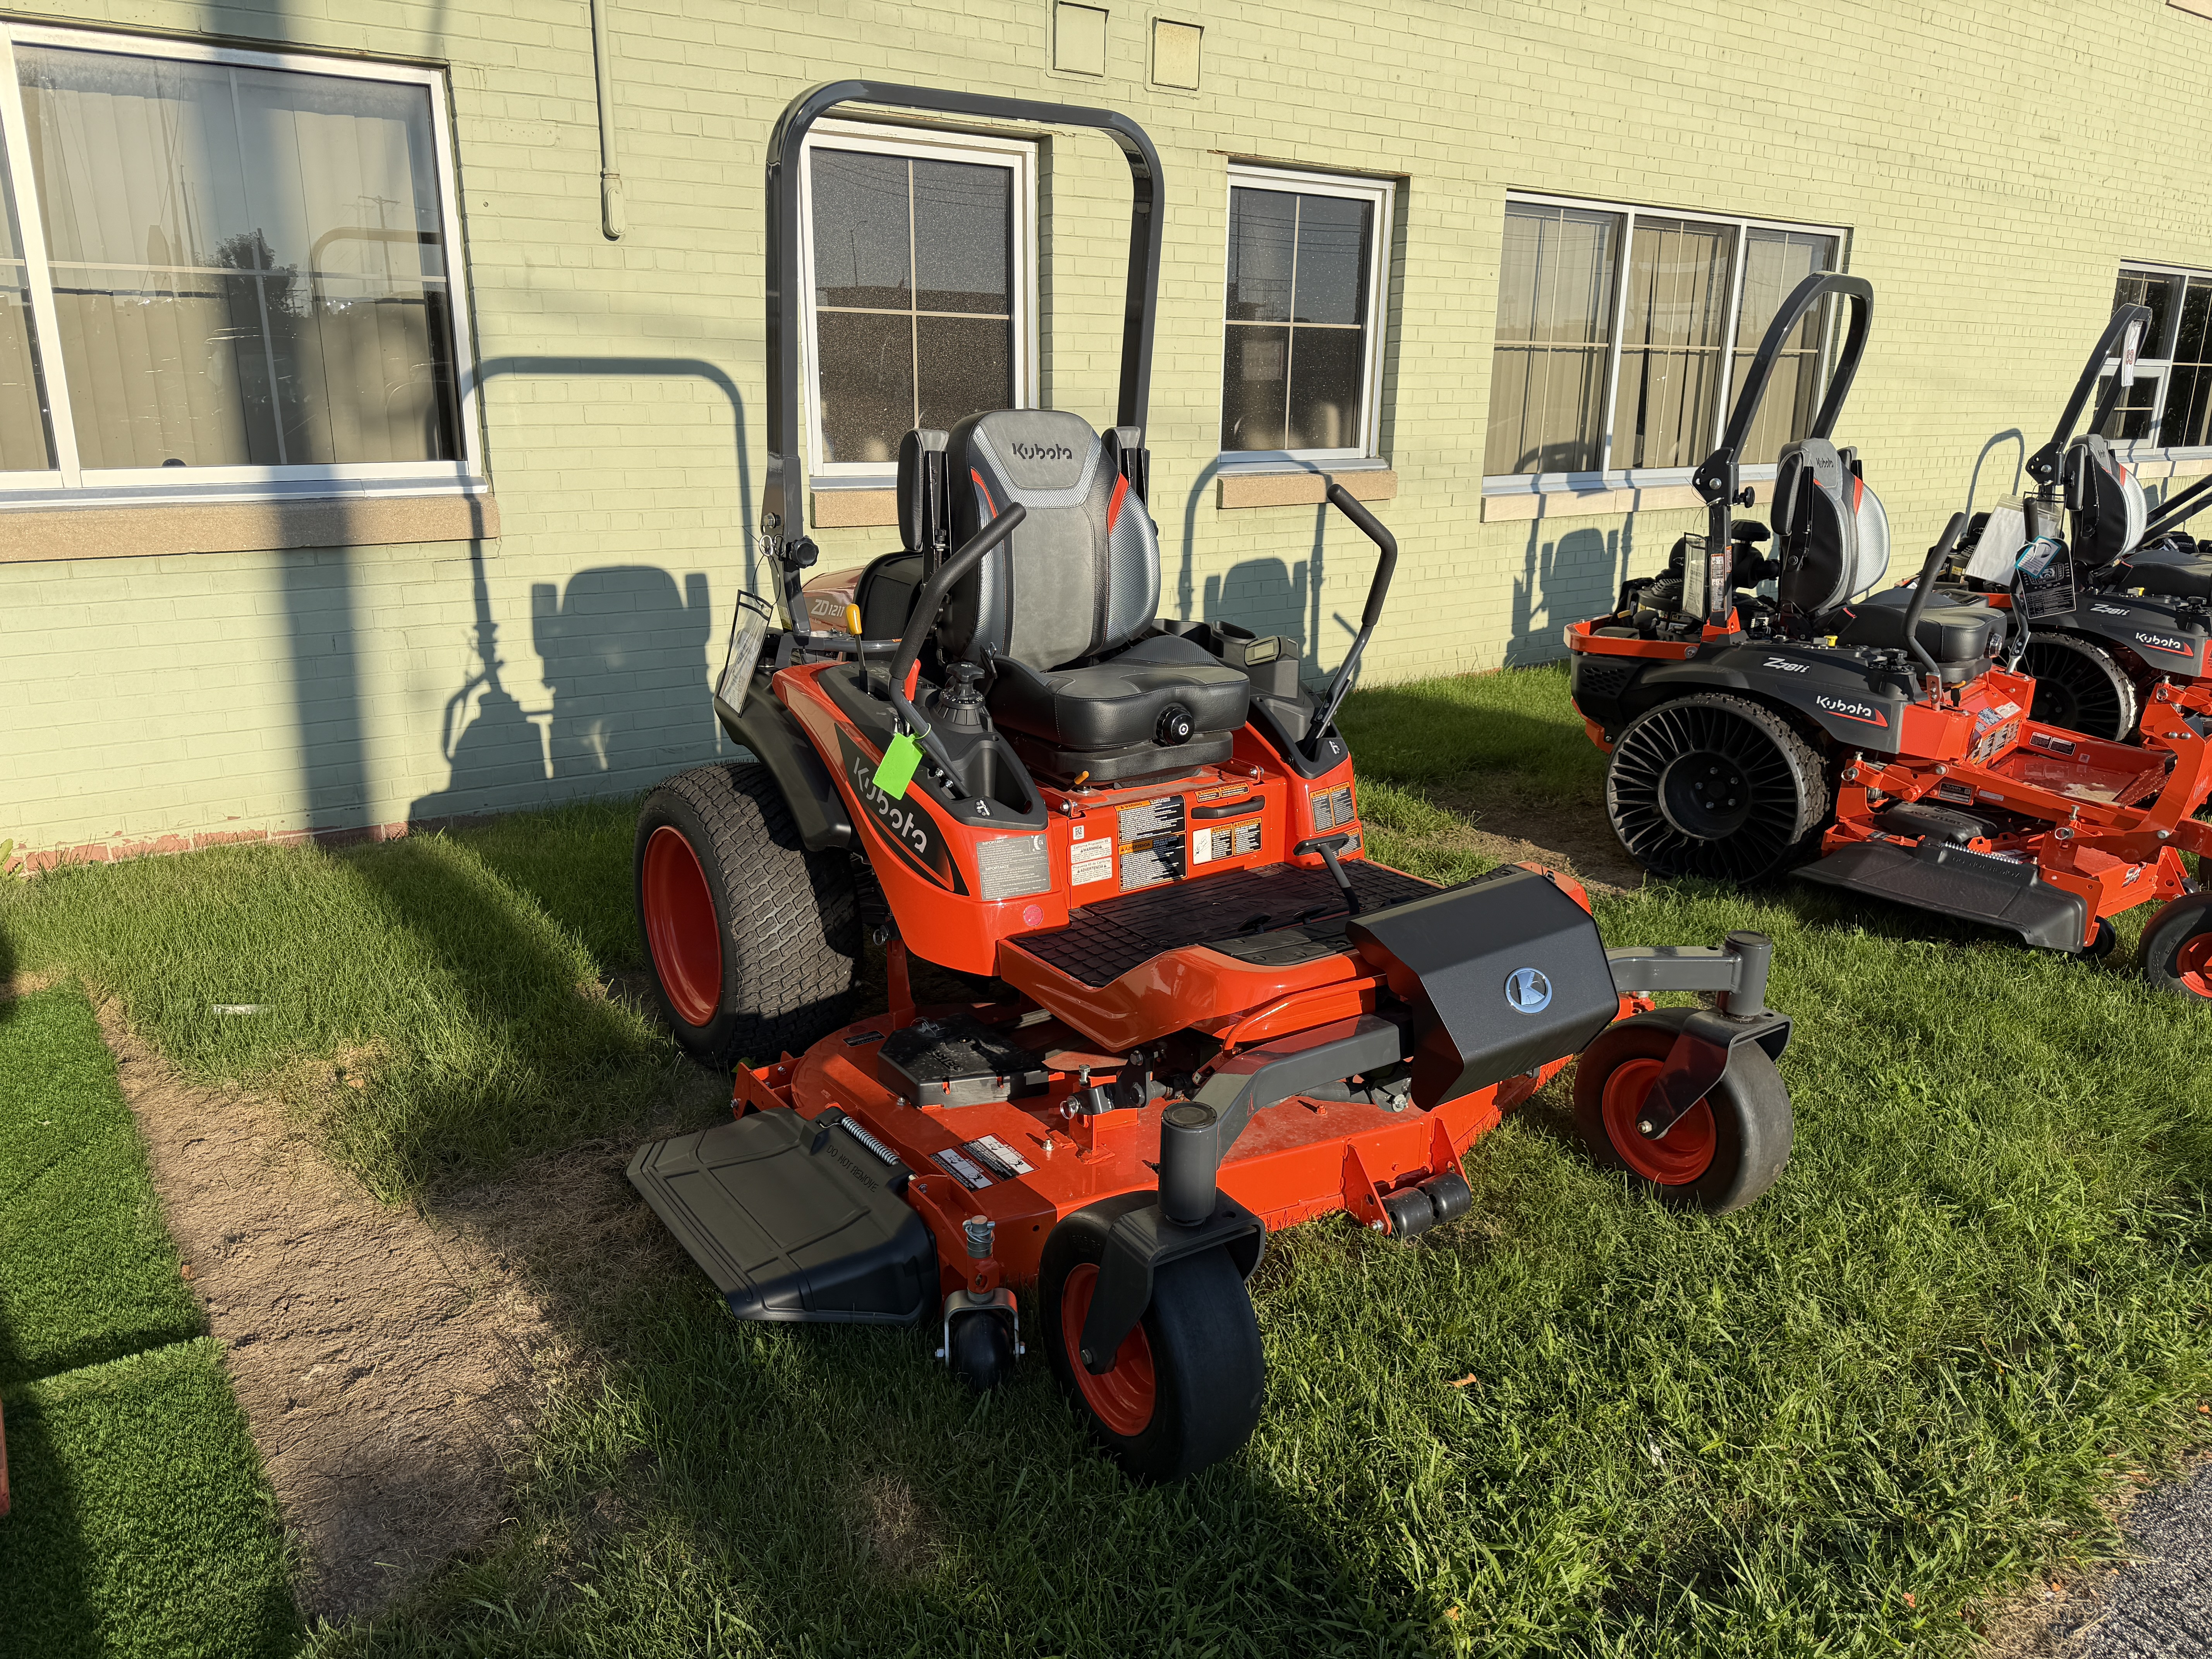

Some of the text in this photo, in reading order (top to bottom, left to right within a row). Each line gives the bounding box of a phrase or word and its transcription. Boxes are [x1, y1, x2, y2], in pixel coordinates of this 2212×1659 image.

[1012, 443, 1072, 459] Kubota
[1816, 457, 1834, 468] Kubota
[811, 599, 845, 617] ZD 1211
[2090, 604, 2130, 616] Z781i
[2135, 632, 2181, 649] Kubota
[1763, 657, 1810, 673] Z781i
[1816, 696, 1872, 717] Kubota
[853, 756, 927, 854] Kubota
[826, 1145, 879, 1192] DO NOT REMOVE
[968, 1160, 985, 1173] DANGER
